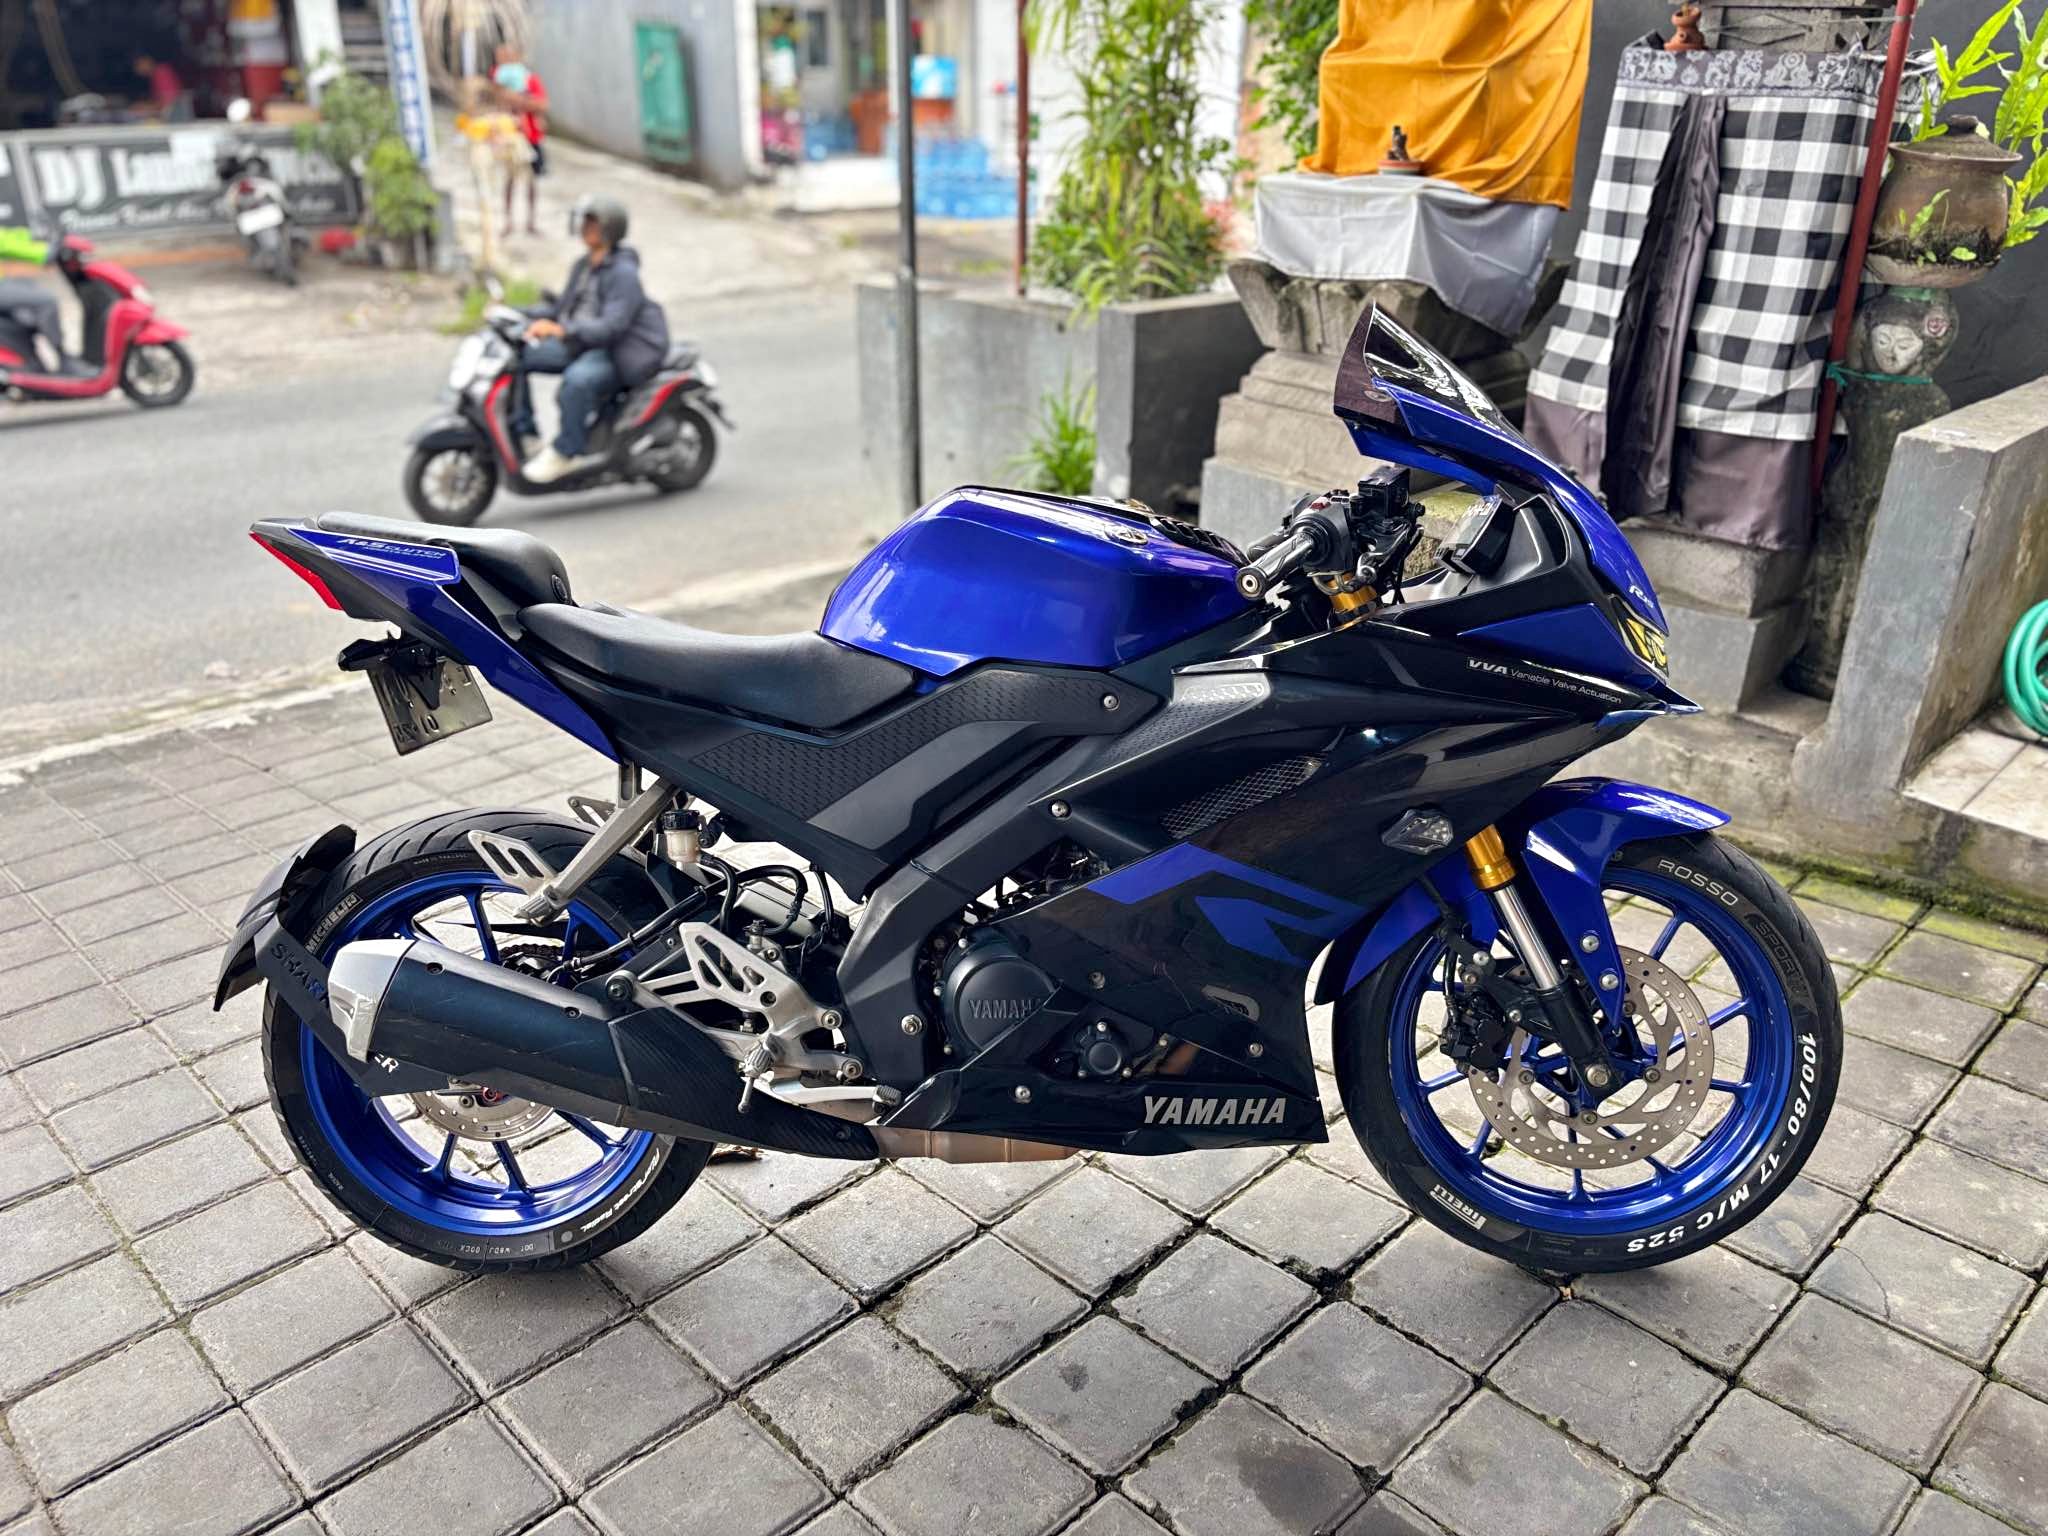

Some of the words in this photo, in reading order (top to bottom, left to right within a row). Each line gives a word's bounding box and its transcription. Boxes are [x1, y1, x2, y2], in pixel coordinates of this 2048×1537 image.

[36, 147, 106, 209] DJ
[1469, 659, 1508, 675] VVA
[1511, 668, 1550, 685] Variable
[1552, 678, 1577, 691] Valve
[1578, 686, 1622, 704] Actuation
[1657, 859, 1738, 906] ROSSO
[304, 892, 360, 953] MICHELIN
[967, 998, 1042, 1019] YAMAH
[1787, 1032, 1817, 1135] 100/80
[1143, 1096, 1287, 1125] YAMAHA
[1760, 1152, 1781, 1185] 17
[1429, 1184, 1487, 1230] PIRELLI
[1696, 1183, 1750, 1230] M/C
[1627, 1225, 1685, 1253] 52S
